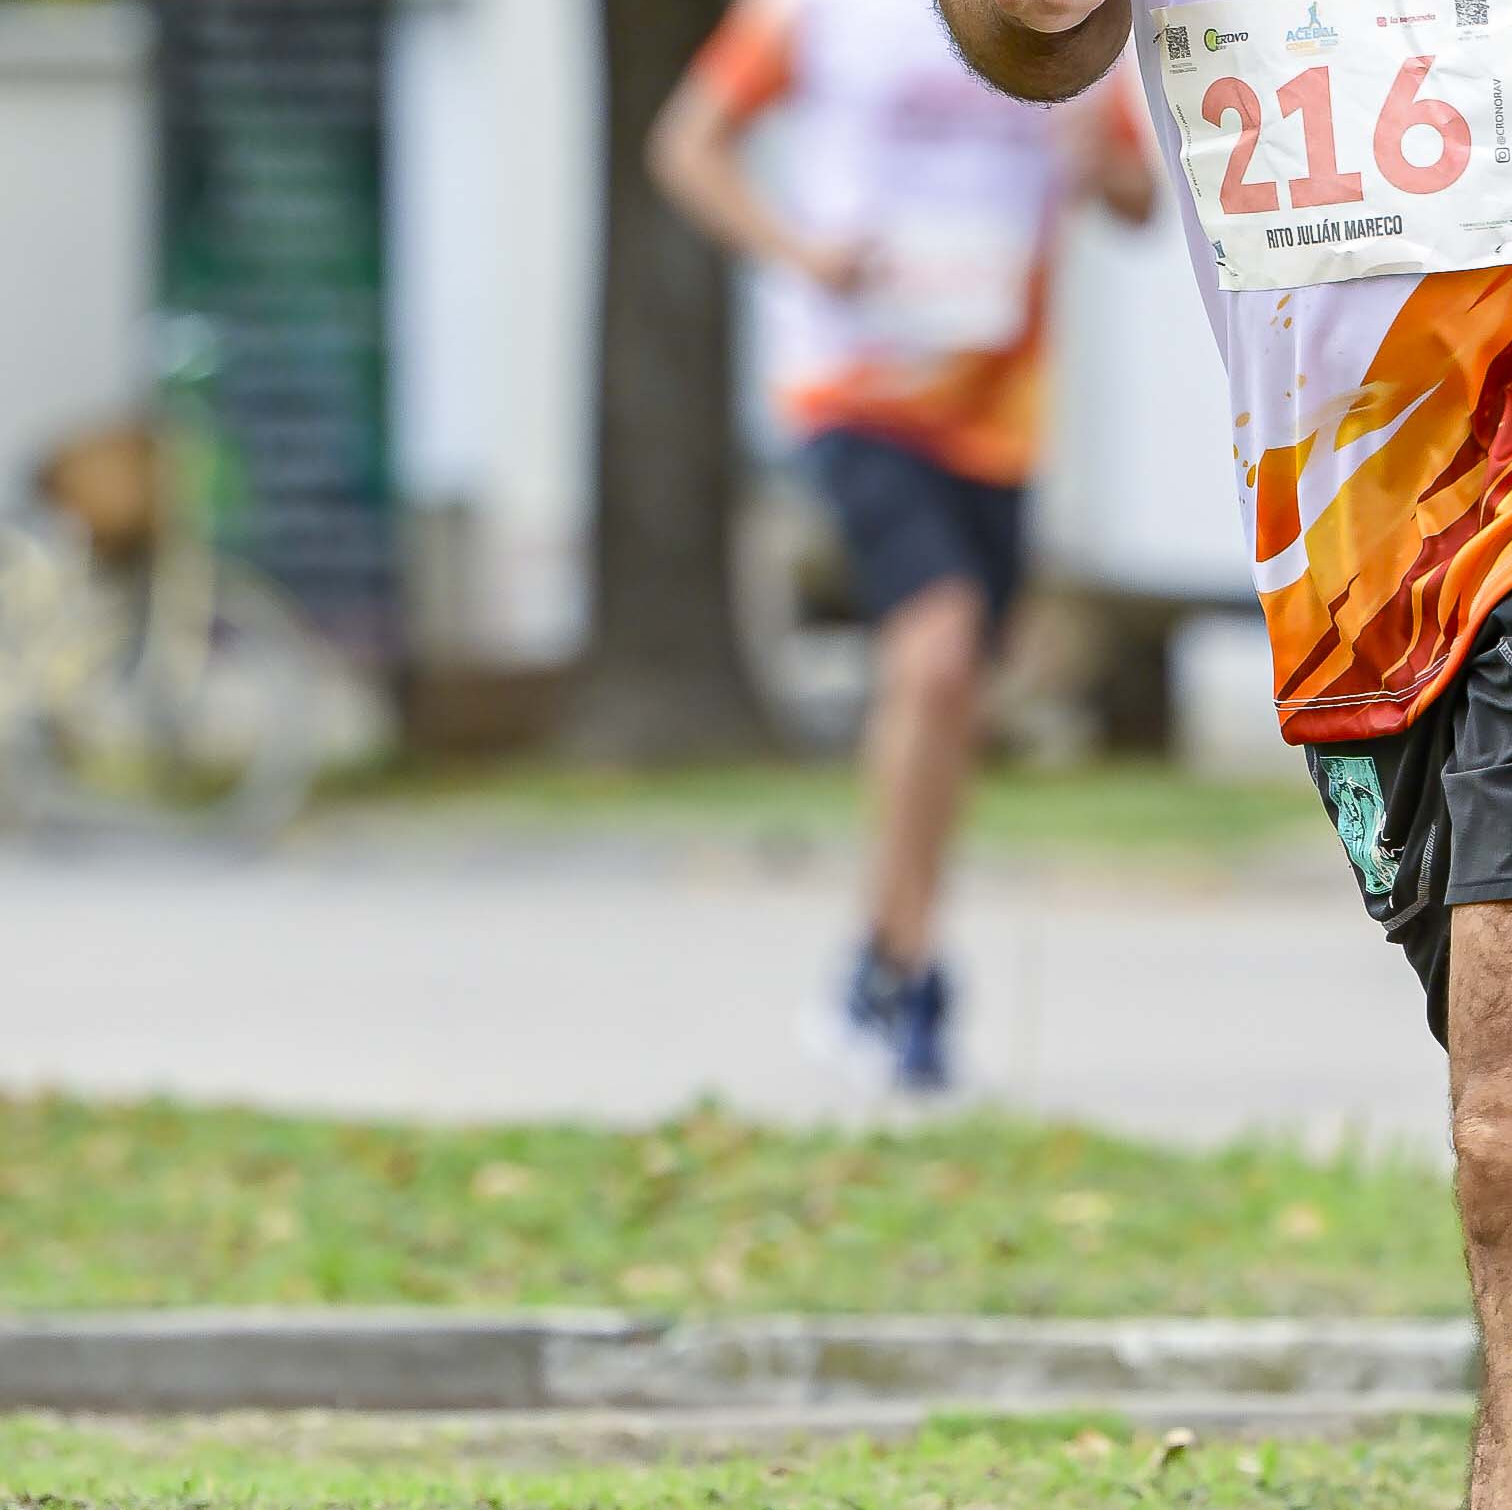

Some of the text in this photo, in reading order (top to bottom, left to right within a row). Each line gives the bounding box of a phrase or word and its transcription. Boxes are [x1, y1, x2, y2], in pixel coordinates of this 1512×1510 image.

[1201, 54, 1472, 215] 216
[1494, 78, 1506, 145] @CRONORAV
[1266, 214, 1404, 249] RITO JULIÁN MARECO
